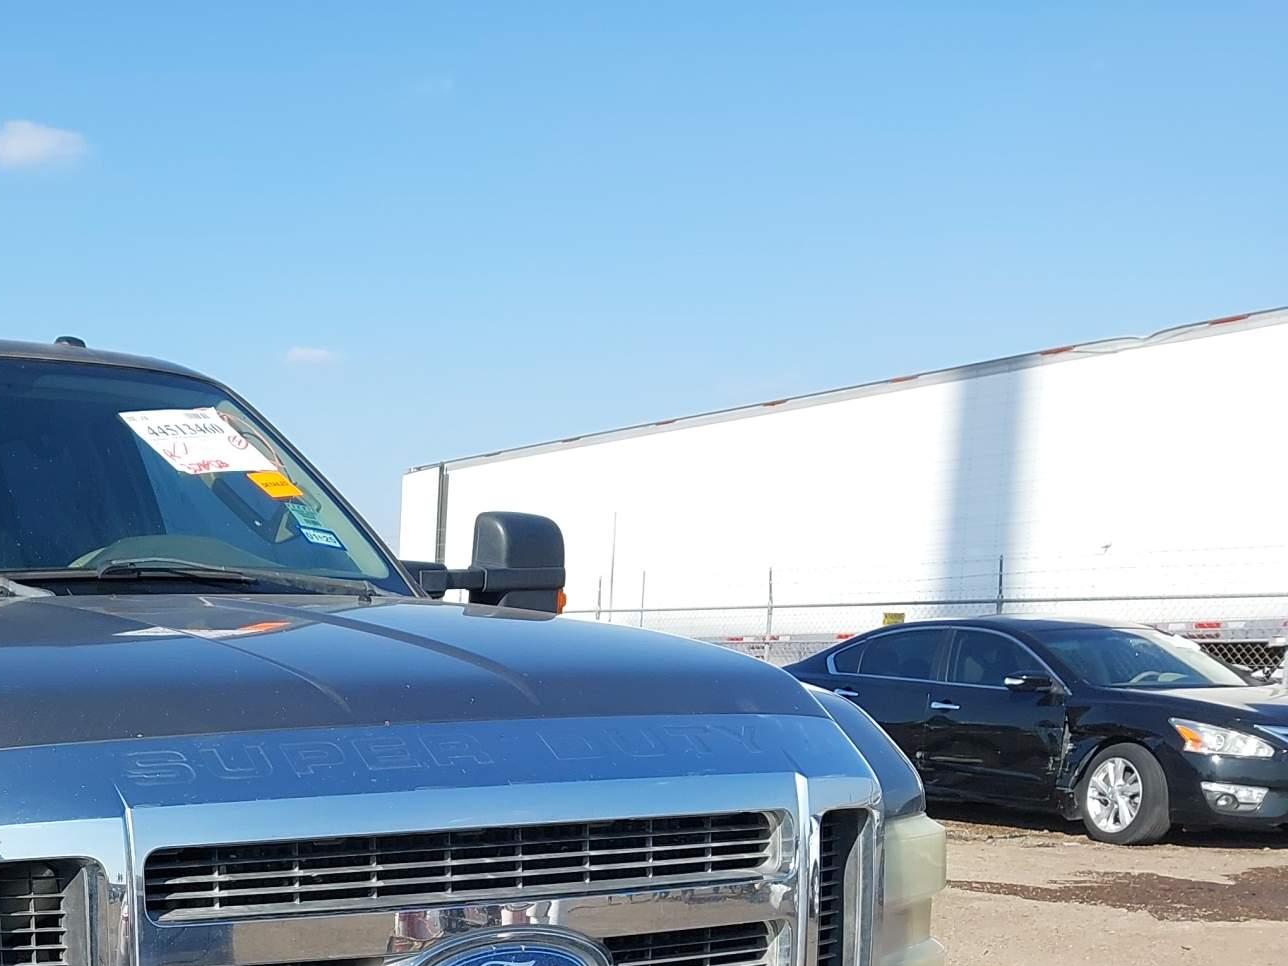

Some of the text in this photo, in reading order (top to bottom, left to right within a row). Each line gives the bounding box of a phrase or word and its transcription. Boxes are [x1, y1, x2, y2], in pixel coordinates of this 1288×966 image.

[147, 422, 225, 437] 44513460
[125, 723, 767, 786] SUPER DUTY
